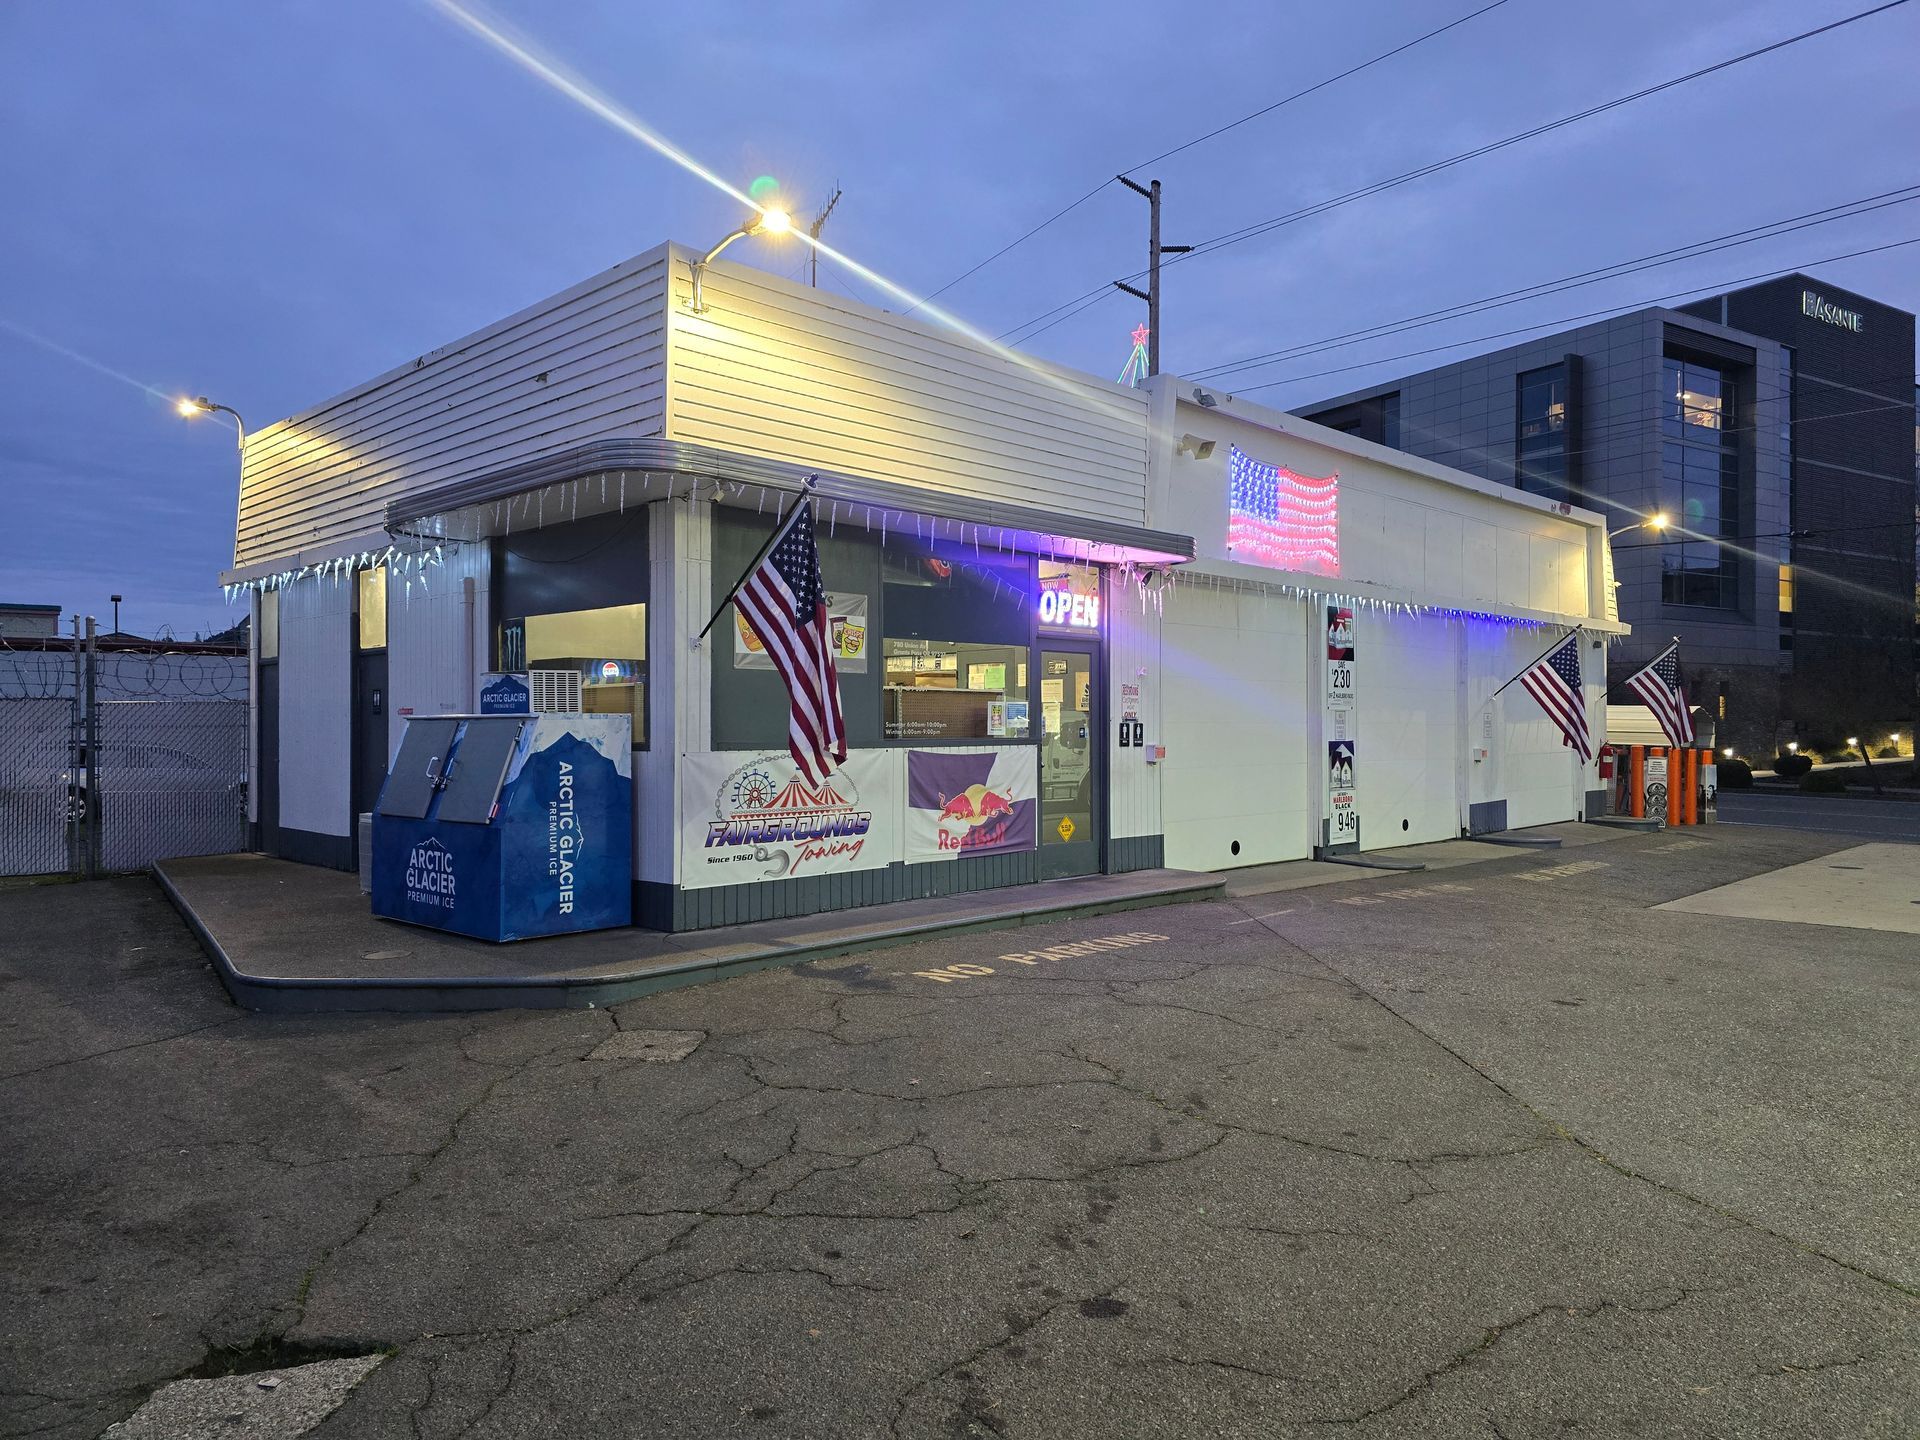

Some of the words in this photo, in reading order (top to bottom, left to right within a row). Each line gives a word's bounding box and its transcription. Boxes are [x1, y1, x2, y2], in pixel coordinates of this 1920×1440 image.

[1814, 296, 1863, 333] ASANTE
[1041, 581, 1059, 592] NOW
[1040, 590, 1099, 628] OPEN
[843, 627, 863, 639] CRISPS
[482, 693, 503, 703] ARCTIC
[503, 691, 527, 703] GLACIER
[559, 761, 573, 831] ARCTIC
[549, 801, 557, 853] PREMIUM
[704, 811, 872, 848] FAIRGROUNDS
[938, 826, 972, 850] Red
[974, 821, 1008, 848] Bull
[409, 848, 453, 873] ARCTIC
[549, 858, 557, 876] ICE
[707, 856, 730, 864] Since
[732, 853, 754, 862] 1960
[789, 835, 865, 876] Towing
[406, 867, 456, 896] GLACIER
[559, 835, 574, 915] GLACIER
[407, 890, 440, 906] PREMIUM
[442, 896, 455, 909] ICE
[911, 963, 995, 983] NO
[997, 931, 1170, 965] PARKING
